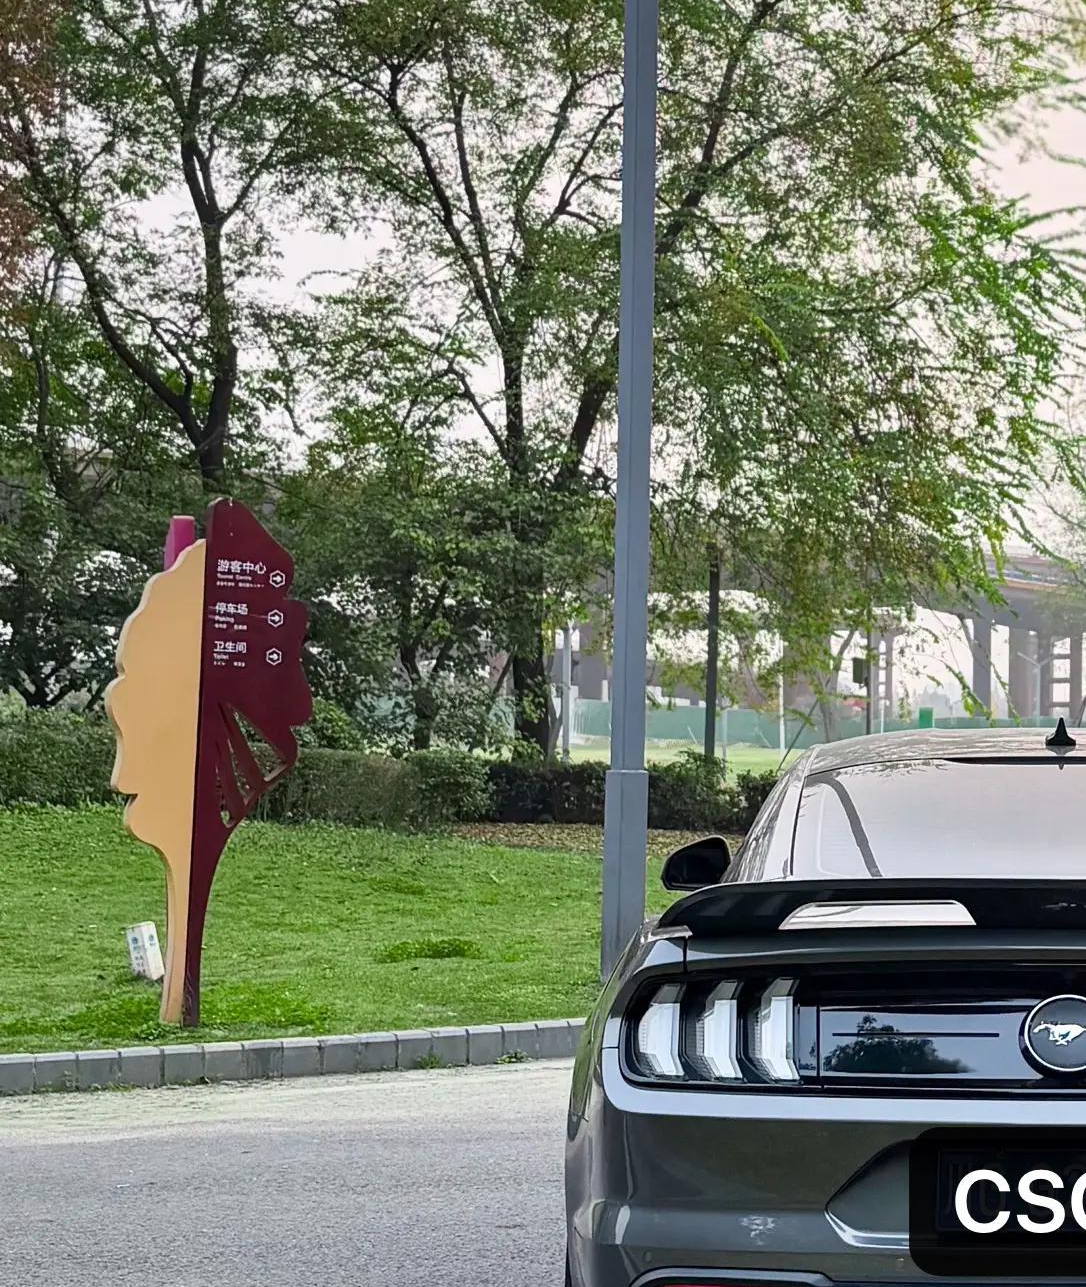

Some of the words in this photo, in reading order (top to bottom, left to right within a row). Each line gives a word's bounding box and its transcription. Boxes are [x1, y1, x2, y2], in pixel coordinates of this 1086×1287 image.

[217, 559, 267, 574] 游客中心
[215, 602, 248, 616] 停车场
[213, 640, 247, 653] 卫生间
